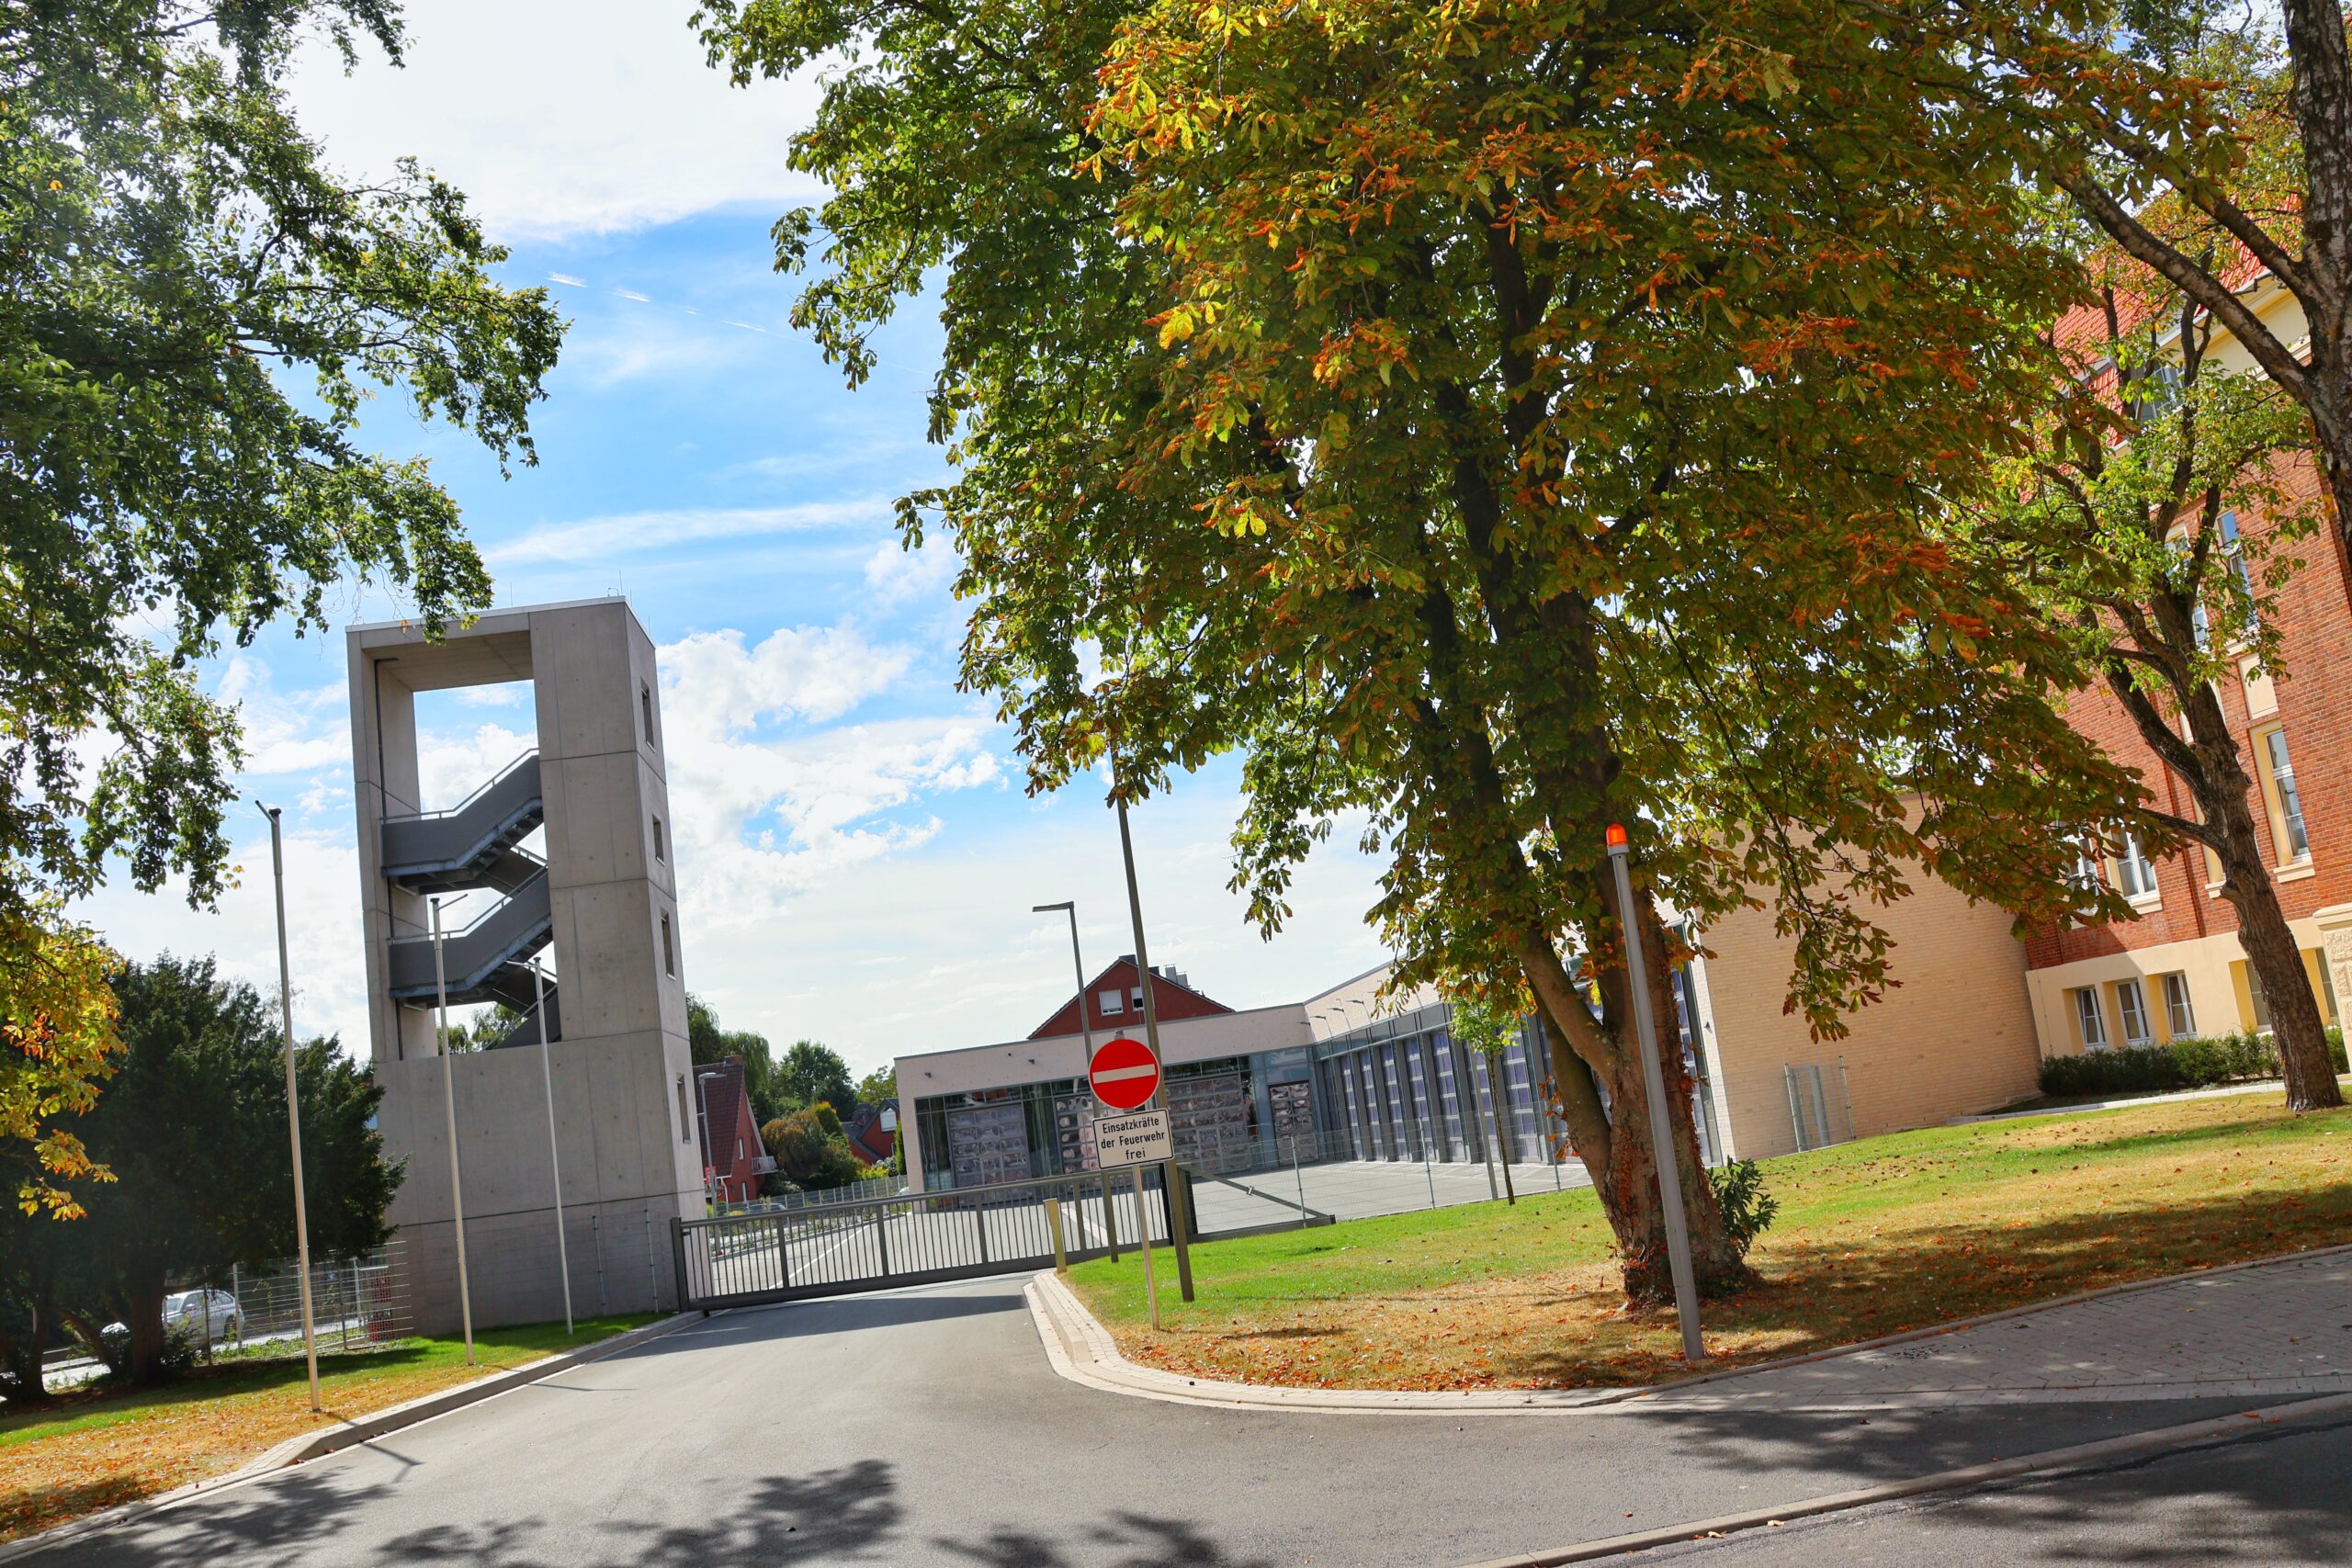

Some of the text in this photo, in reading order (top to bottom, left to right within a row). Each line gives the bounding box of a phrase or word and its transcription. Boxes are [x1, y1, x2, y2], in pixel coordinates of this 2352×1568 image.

[1102, 1117, 1159, 1134] Einsatzkräfte
[1101, 1131, 1165, 1148] der Feuerwehr
[1125, 1147, 1146, 1160] frei
